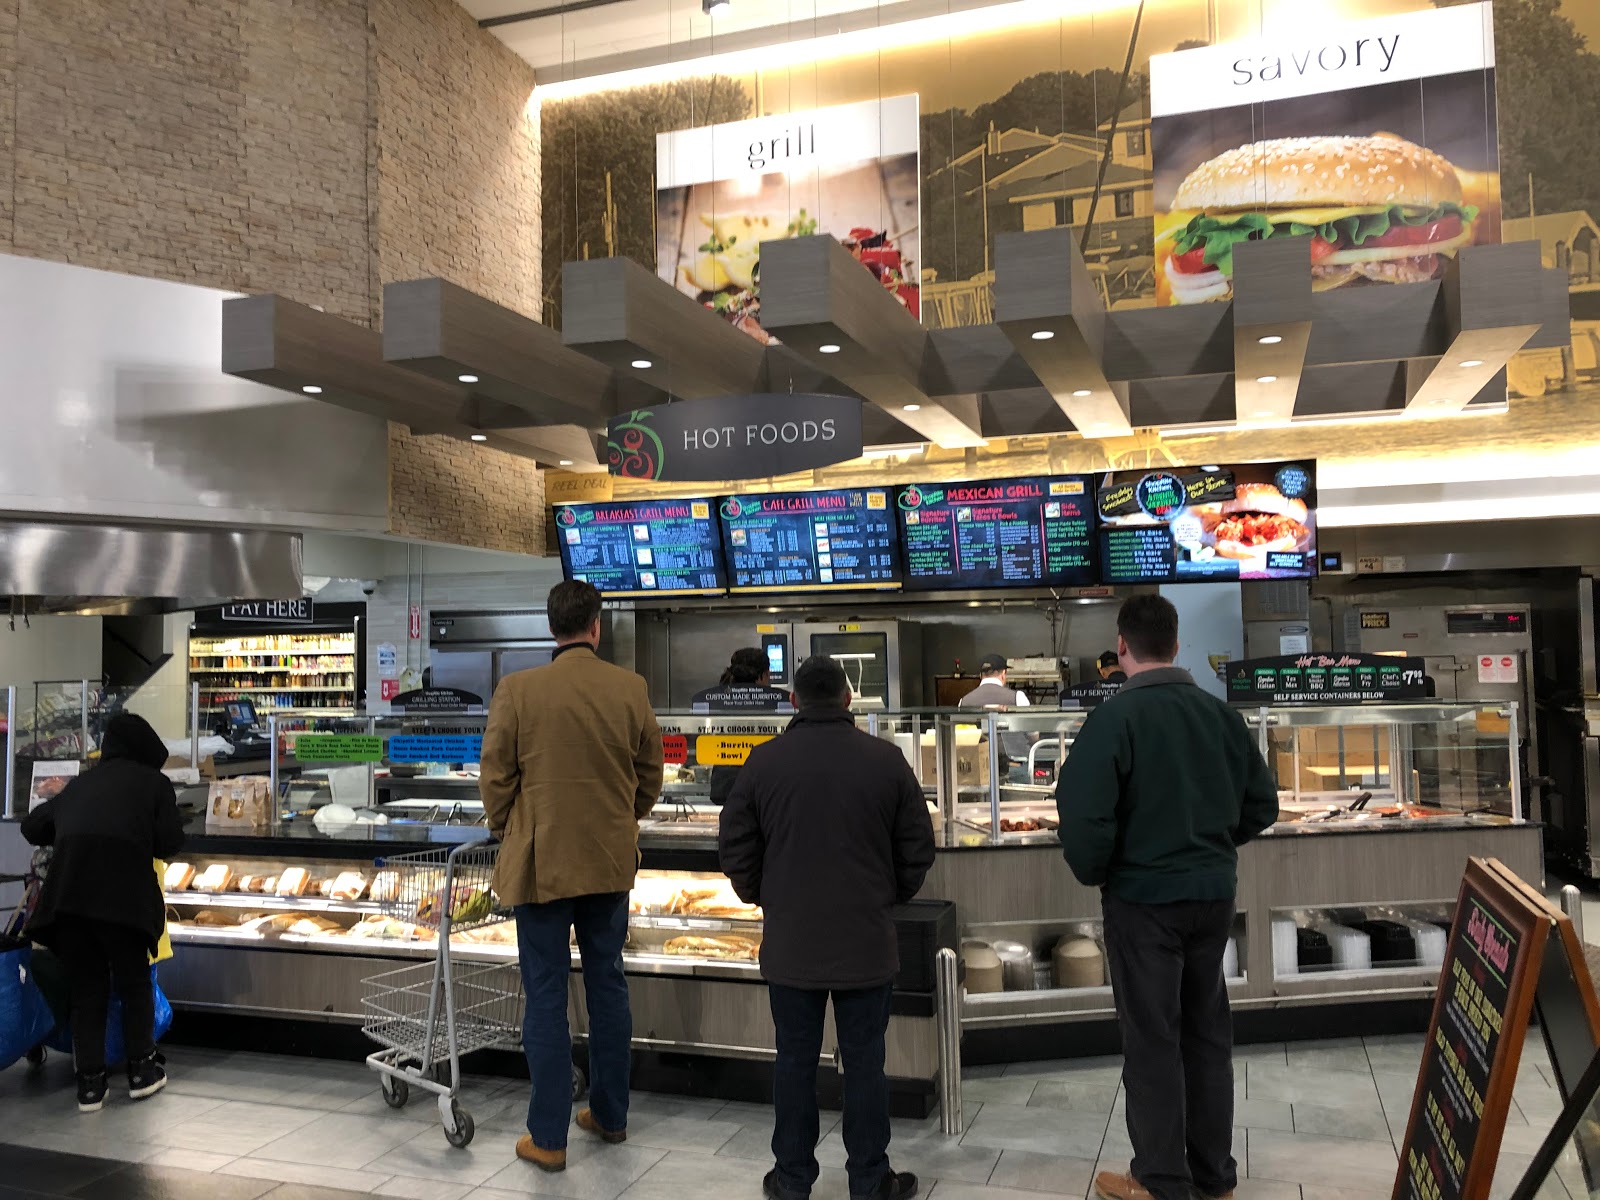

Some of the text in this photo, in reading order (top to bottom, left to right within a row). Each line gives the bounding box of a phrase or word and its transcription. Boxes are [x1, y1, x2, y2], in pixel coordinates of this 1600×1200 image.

[1233, 34, 1400, 85] savory
[748, 124, 814, 170] grill
[684, 419, 836, 450] HOT FOODS
[946, 484, 1043, 501] MEXICAN GRILL
[763, 499, 785, 512] CAFE
[788, 498, 814, 511] GRILL
[817, 496, 846, 509] MENU
[596, 509, 639, 521] BREAKFAST
[640, 508, 662, 519] GRILL
[665, 506, 689, 518] MENU
[266, 600, 307, 618] HERE
[1274, 693, 1290, 701] SELF
[1291, 693, 1319, 701] SERVICE
[1320, 692, 1361, 700] CONTAINERS
